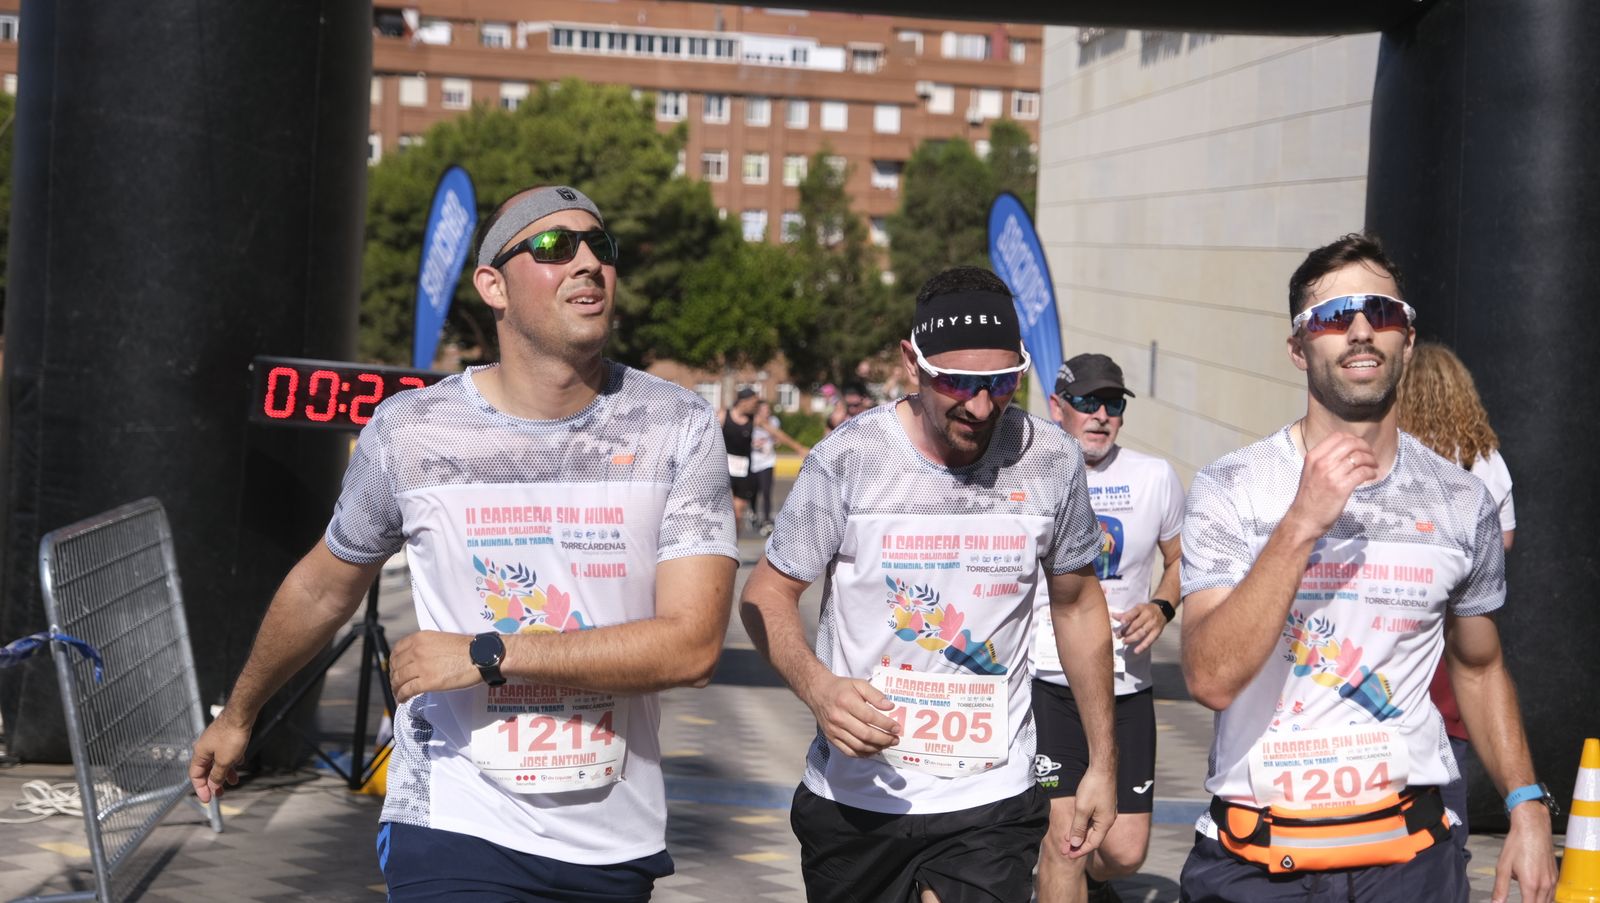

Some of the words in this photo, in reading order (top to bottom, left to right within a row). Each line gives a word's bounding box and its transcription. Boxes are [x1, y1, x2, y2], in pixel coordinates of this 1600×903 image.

[465, 507, 476, 524] II
[481, 506, 552, 524] CARRERA
[556, 507, 579, 524] SIN
[585, 507, 624, 525] HUMO
[480, 538, 513, 546] MUNDIAL
[515, 537, 527, 546] SIN
[560, 540, 626, 551] TORRECÁRDENAS
[883, 535, 893, 550] II
[896, 535, 960, 550] CARRERA
[964, 535, 988, 550] SIN
[993, 535, 1026, 550] HUMO
[584, 563, 627, 578] JUNIO
[894, 562, 923, 570] MUNDIAL
[925, 562, 935, 570] SIN
[937, 561, 960, 569] TABACO
[966, 564, 1023, 573] TORRECÁRDENAS
[1363, 564, 1389, 580] SIN
[1394, 566, 1434, 584] HUMO
[972, 583, 982, 598] 4
[987, 583, 1019, 598] JUNIO
[501, 685, 556, 698] CARRERA
[886, 676, 893, 687] II
[896, 678, 945, 695] CARRERA
[948, 682, 966, 694] SIN
[969, 683, 995, 695] HUMO
[497, 710, 616, 753] 1214
[889, 706, 993, 744] 1205
[1262, 741, 1270, 754] II
[1273, 738, 1329, 754] CARRERA
[1331, 734, 1352, 749] SIN
[1355, 731, 1390, 746] HUMO
[551, 752, 597, 767] ANTONIO
[1273, 761, 1391, 802] 1204
